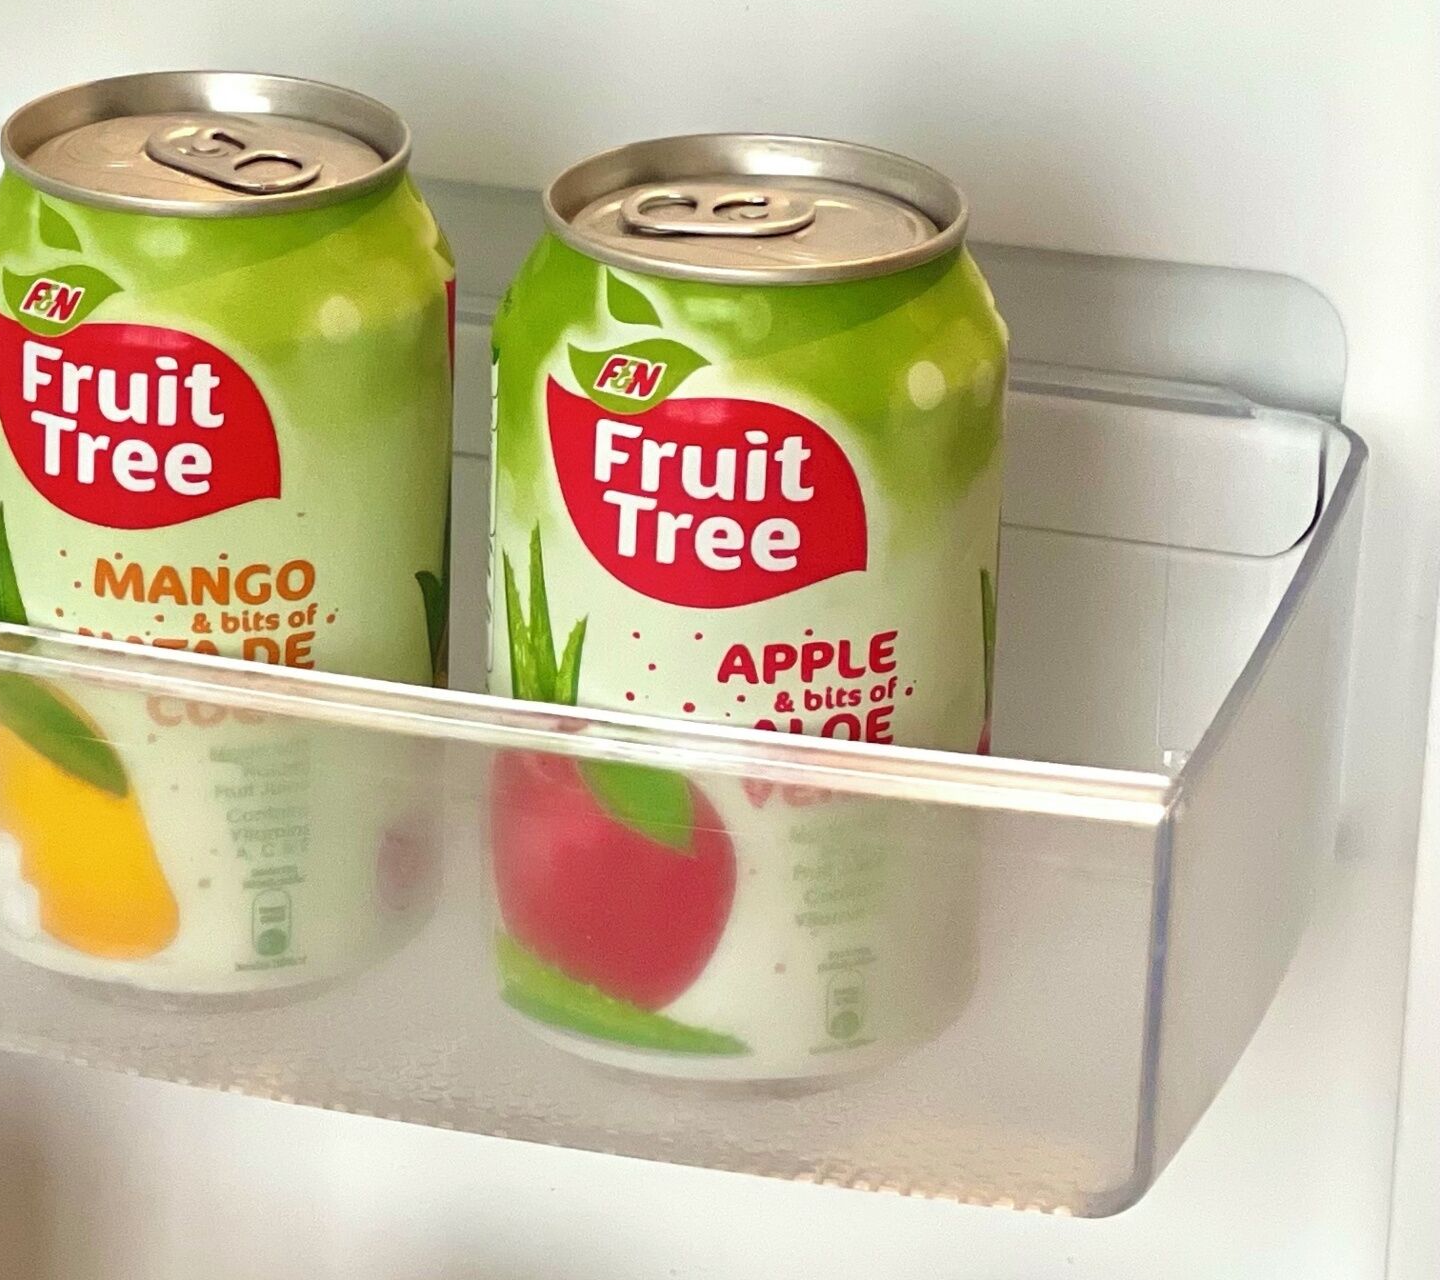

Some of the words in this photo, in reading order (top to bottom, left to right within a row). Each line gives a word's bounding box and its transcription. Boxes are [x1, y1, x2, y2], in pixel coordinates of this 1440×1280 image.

[21, 279, 84, 323] F&N
[22, 340, 225, 429] Fruit
[594, 354, 666, 400] F&N
[30, 410, 213, 497] Tree
[594, 419, 814, 503] Fruit
[602, 490, 801, 572] Tree
[94, 558, 316, 605] MANGO
[191, 612, 212, 634] &
[221, 610, 280, 633] bits
[287, 602, 318, 628] of
[717, 631, 898, 684] APPLE
[774, 691, 795, 712] &
[804, 686, 861, 711] bits
[870, 676, 898, 702] of
